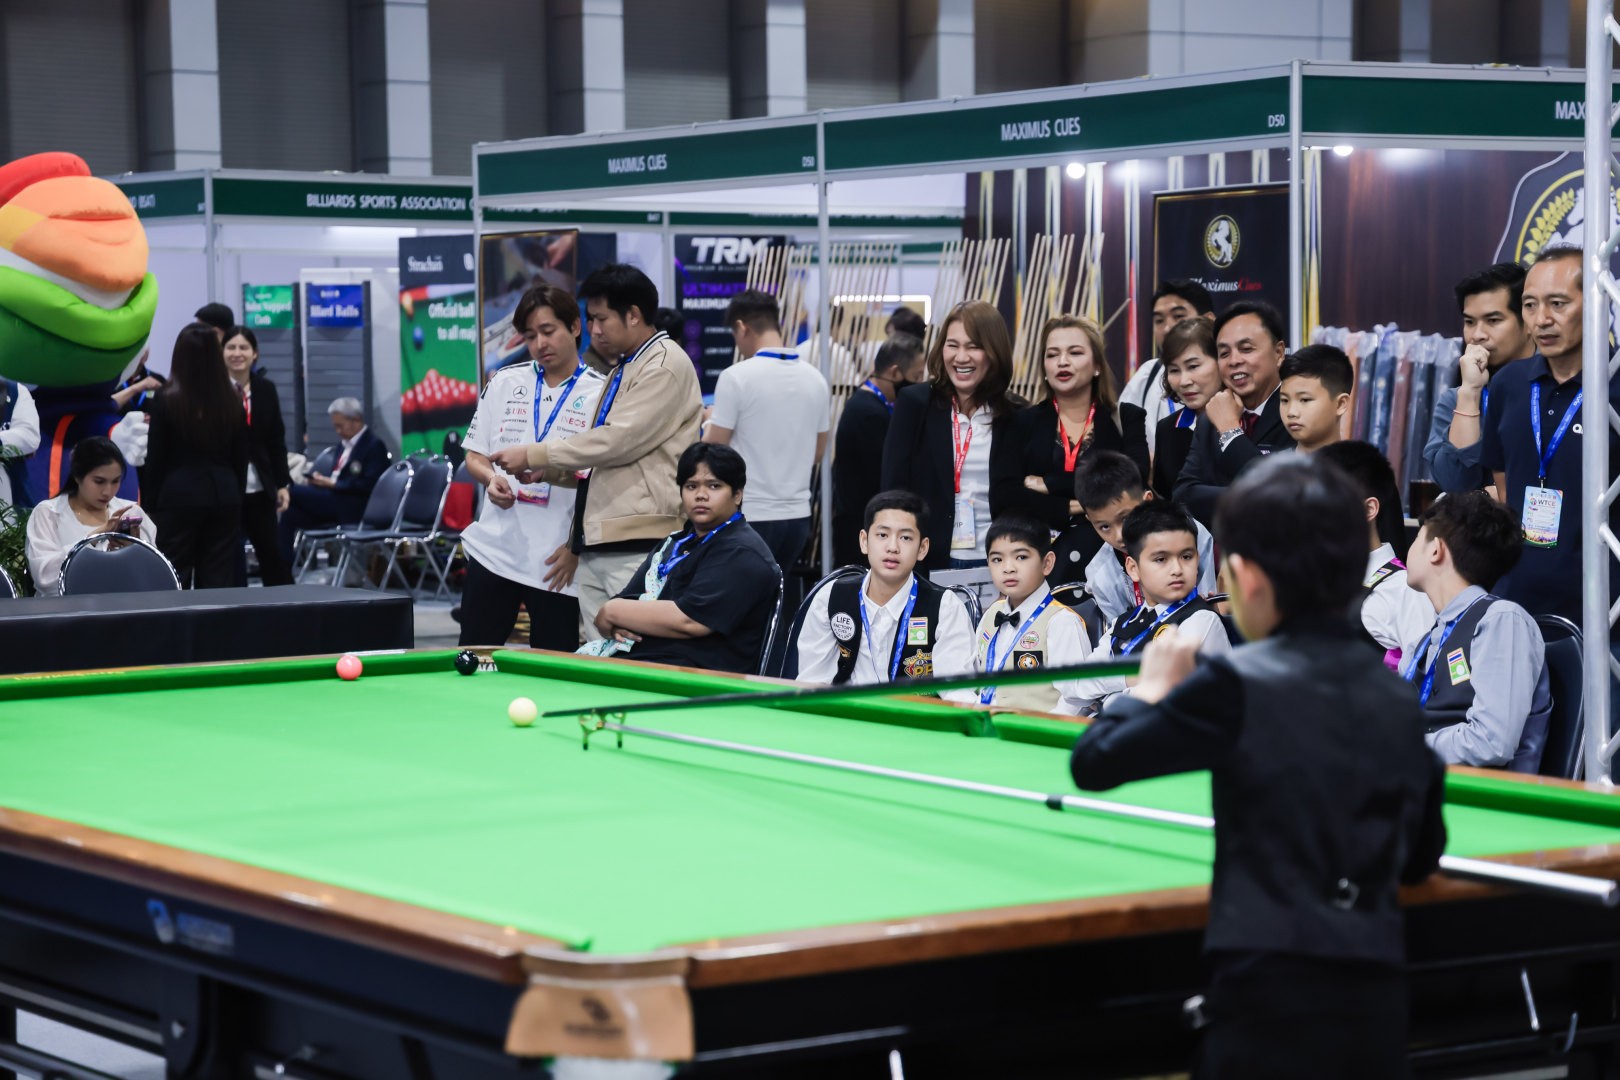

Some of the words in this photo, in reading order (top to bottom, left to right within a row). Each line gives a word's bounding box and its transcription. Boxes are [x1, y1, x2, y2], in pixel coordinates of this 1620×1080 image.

[1555, 101, 1586, 120] MAX
[1001, 119, 1051, 141] MAXIMUS
[1054, 116, 1081, 137] CUES
[1268, 114, 1285, 128] D50
[608, 156, 645, 174] MAXIMUS
[647, 153, 668, 171] CUES
[306, 193, 356, 208] BILLIARDS
[359, 194, 397, 209] SPORTS
[400, 196, 466, 211] ASSOCIATION
[836, 616, 851, 625] LIFE
